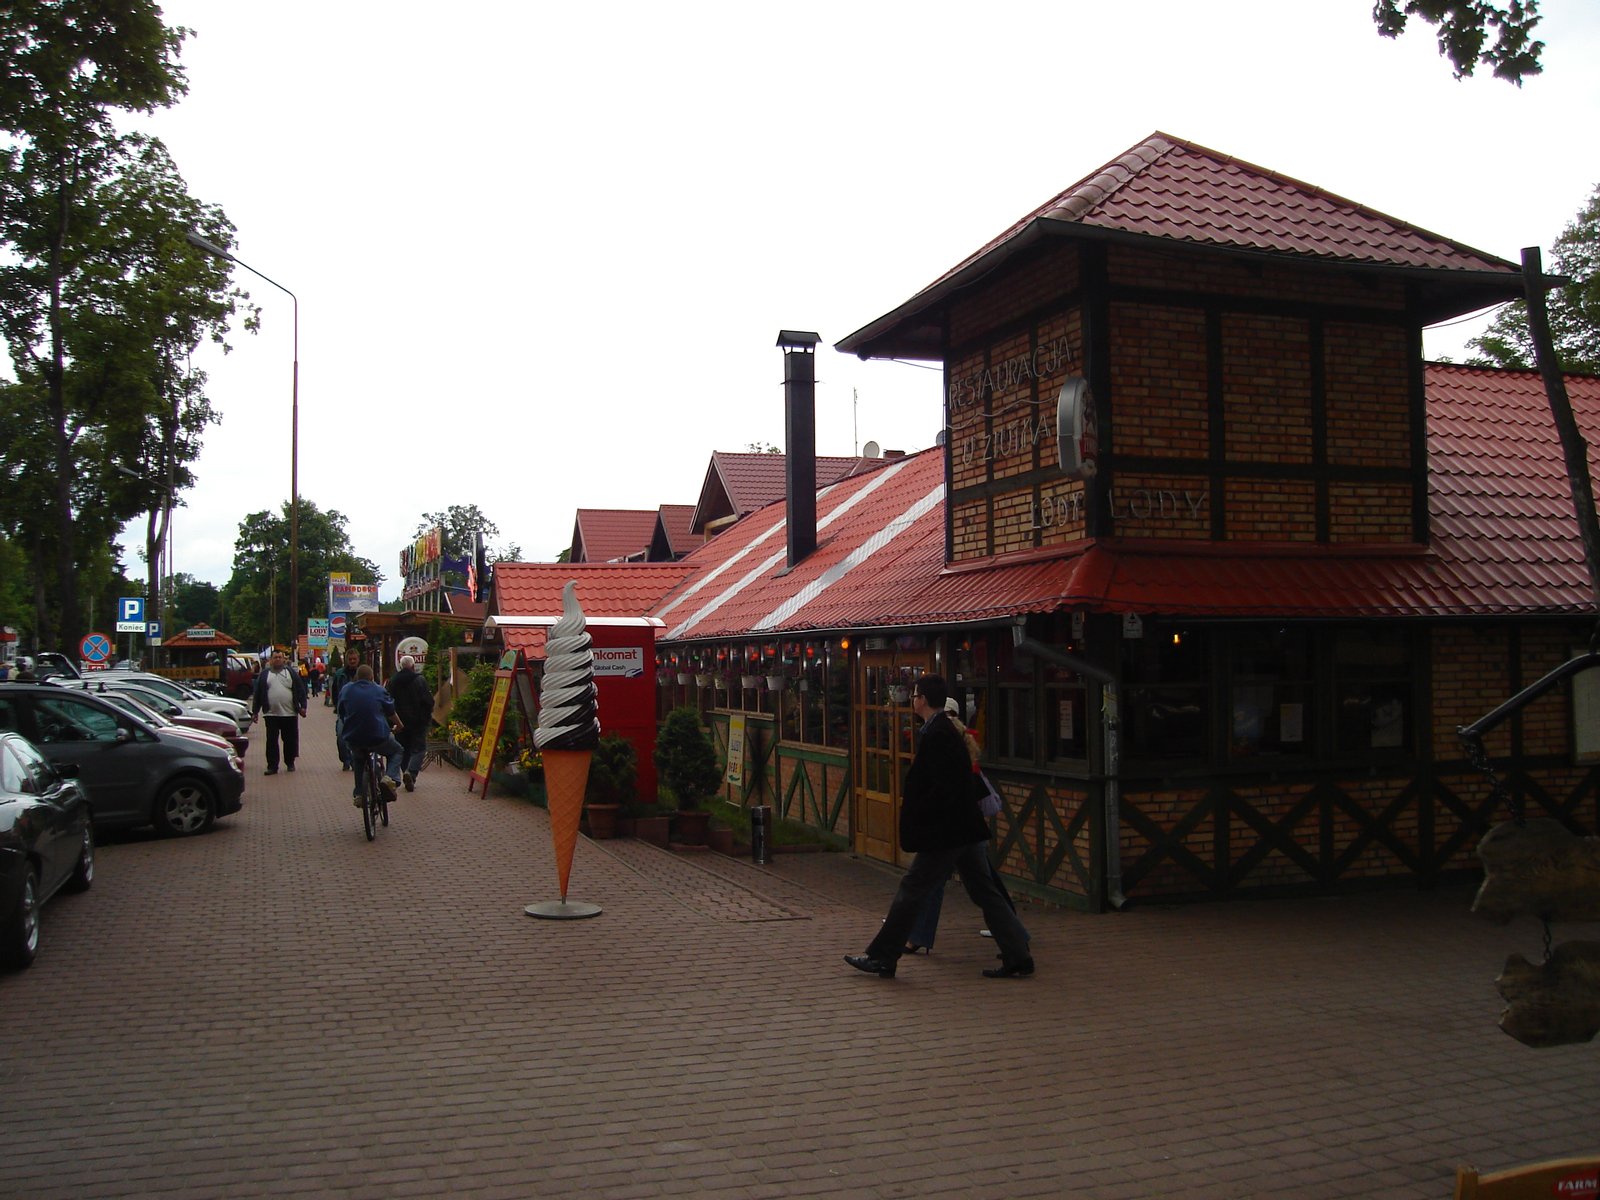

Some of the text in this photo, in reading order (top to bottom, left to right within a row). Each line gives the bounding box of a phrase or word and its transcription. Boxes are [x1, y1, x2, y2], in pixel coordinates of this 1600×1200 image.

[949, 335, 1072, 410] RESTAURACJA
[963, 437, 976, 465] U
[1031, 491, 1085, 529] LODY
[1107, 488, 1208, 520] LODY
[124, 600, 140, 620] P
